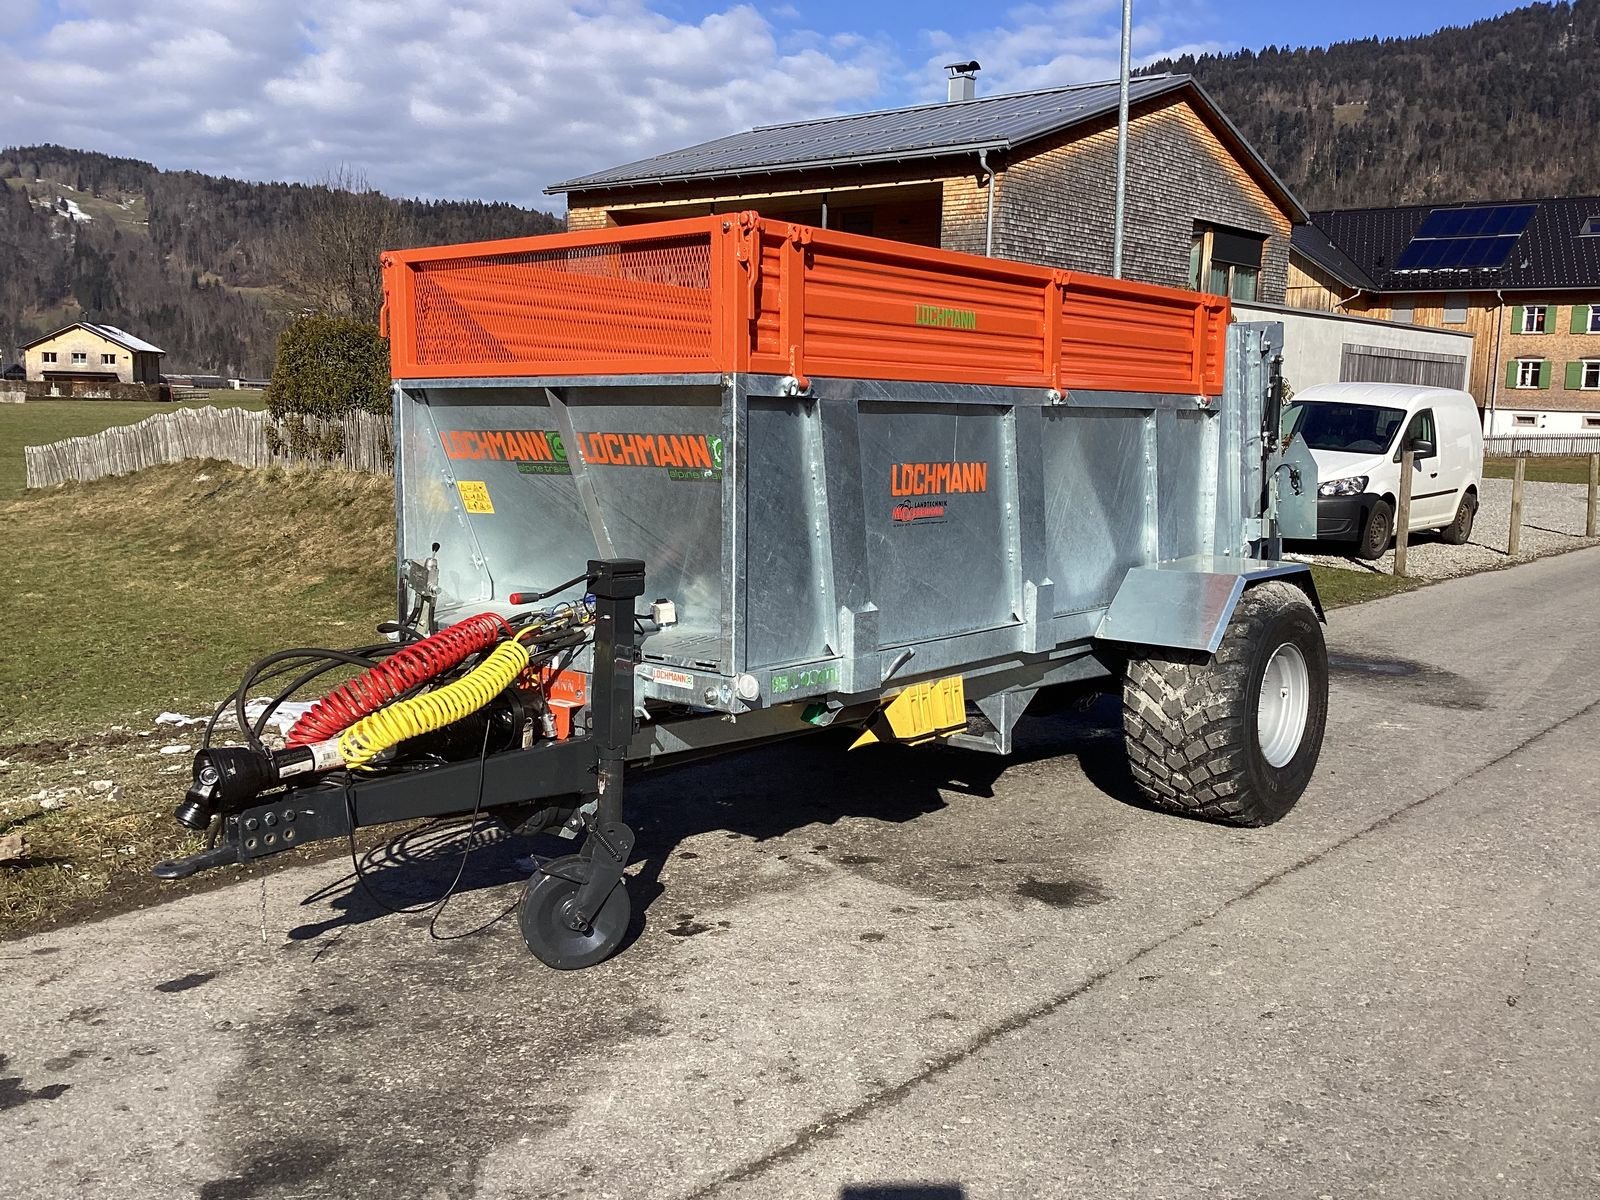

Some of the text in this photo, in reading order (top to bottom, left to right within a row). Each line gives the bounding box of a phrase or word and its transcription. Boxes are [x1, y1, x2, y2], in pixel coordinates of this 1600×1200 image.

[915, 304, 977, 330] LOCHMANN
[440, 430, 553, 461] LOCHMANN
[577, 432, 713, 468] LOCHMANN
[670, 469, 700, 479] alpine
[891, 462, 987, 497] LOCHMANN
[653, 669, 687, 683] LOCHMANN
